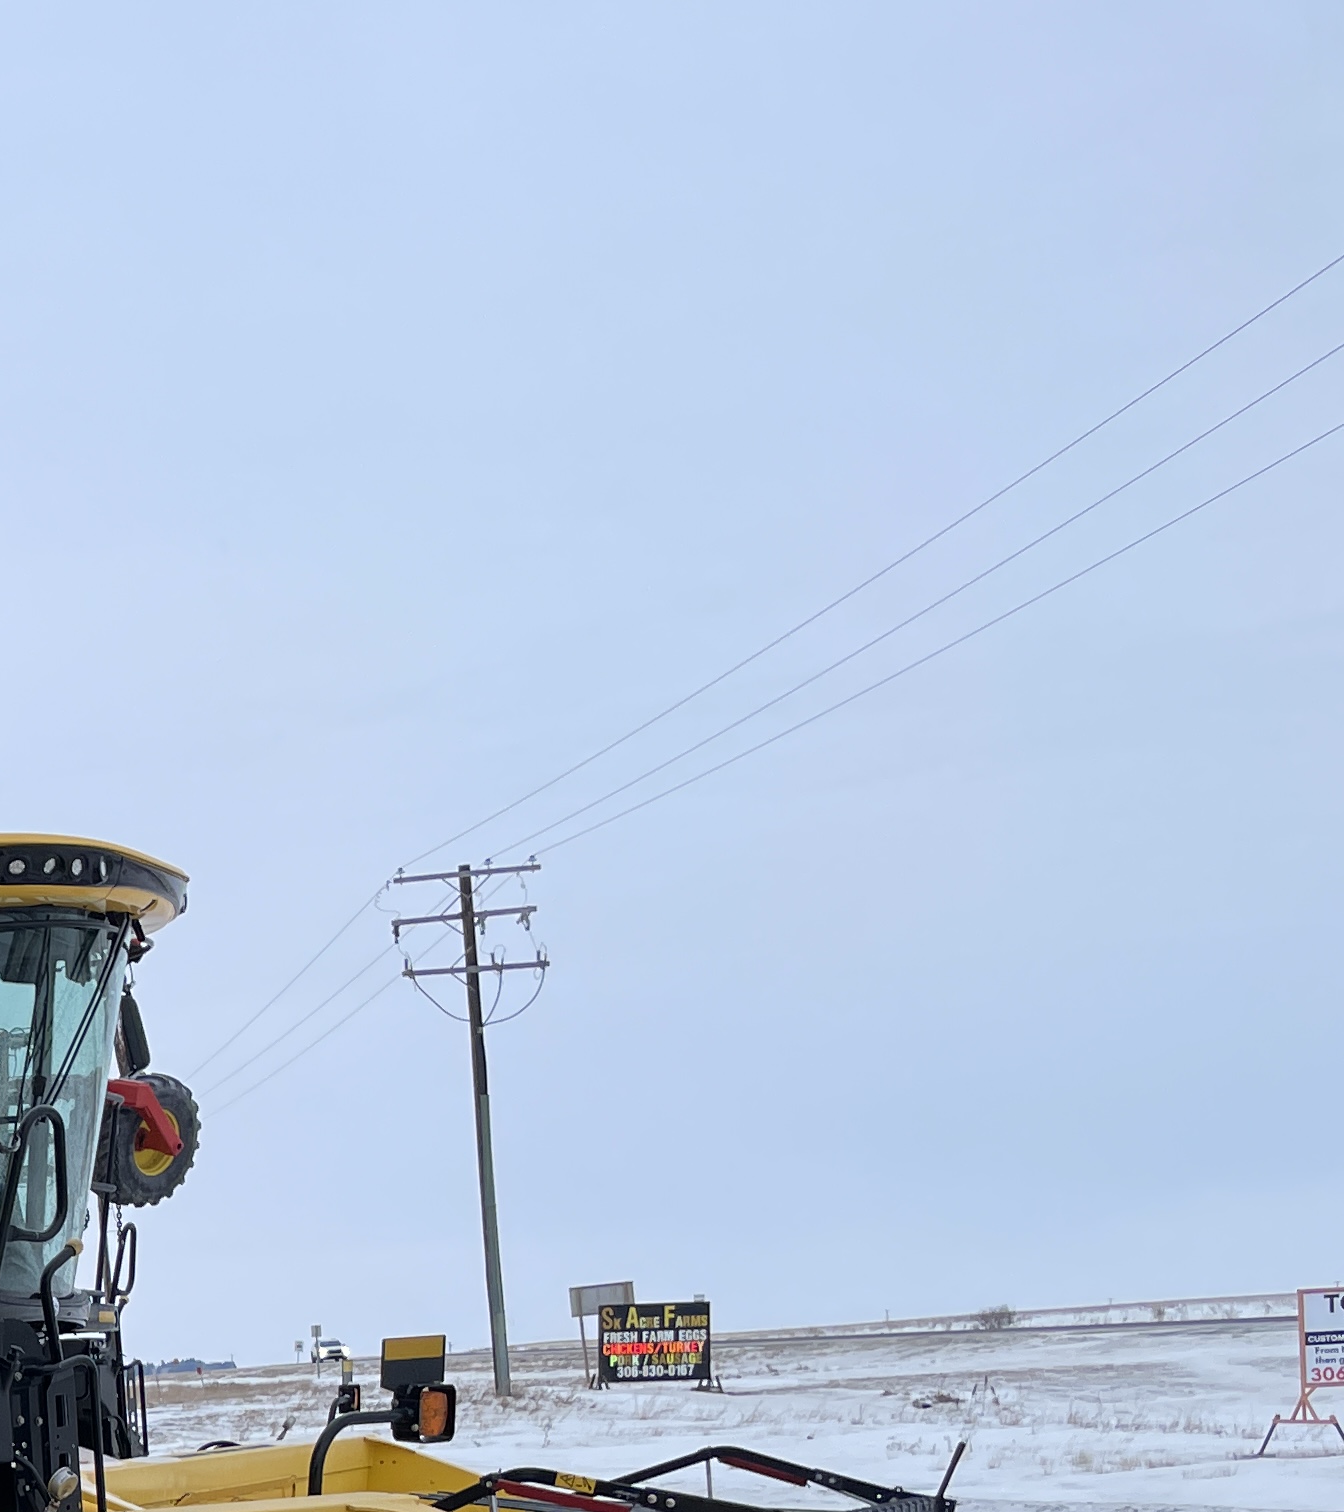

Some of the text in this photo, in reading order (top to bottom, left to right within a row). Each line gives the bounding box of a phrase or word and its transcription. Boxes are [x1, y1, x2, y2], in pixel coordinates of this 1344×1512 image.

[603, 1329, 707, 1343] FRESH FARM EGGS
[610, 1355, 640, 1367] PORK
[651, 1352, 703, 1365] SAUSAGE
